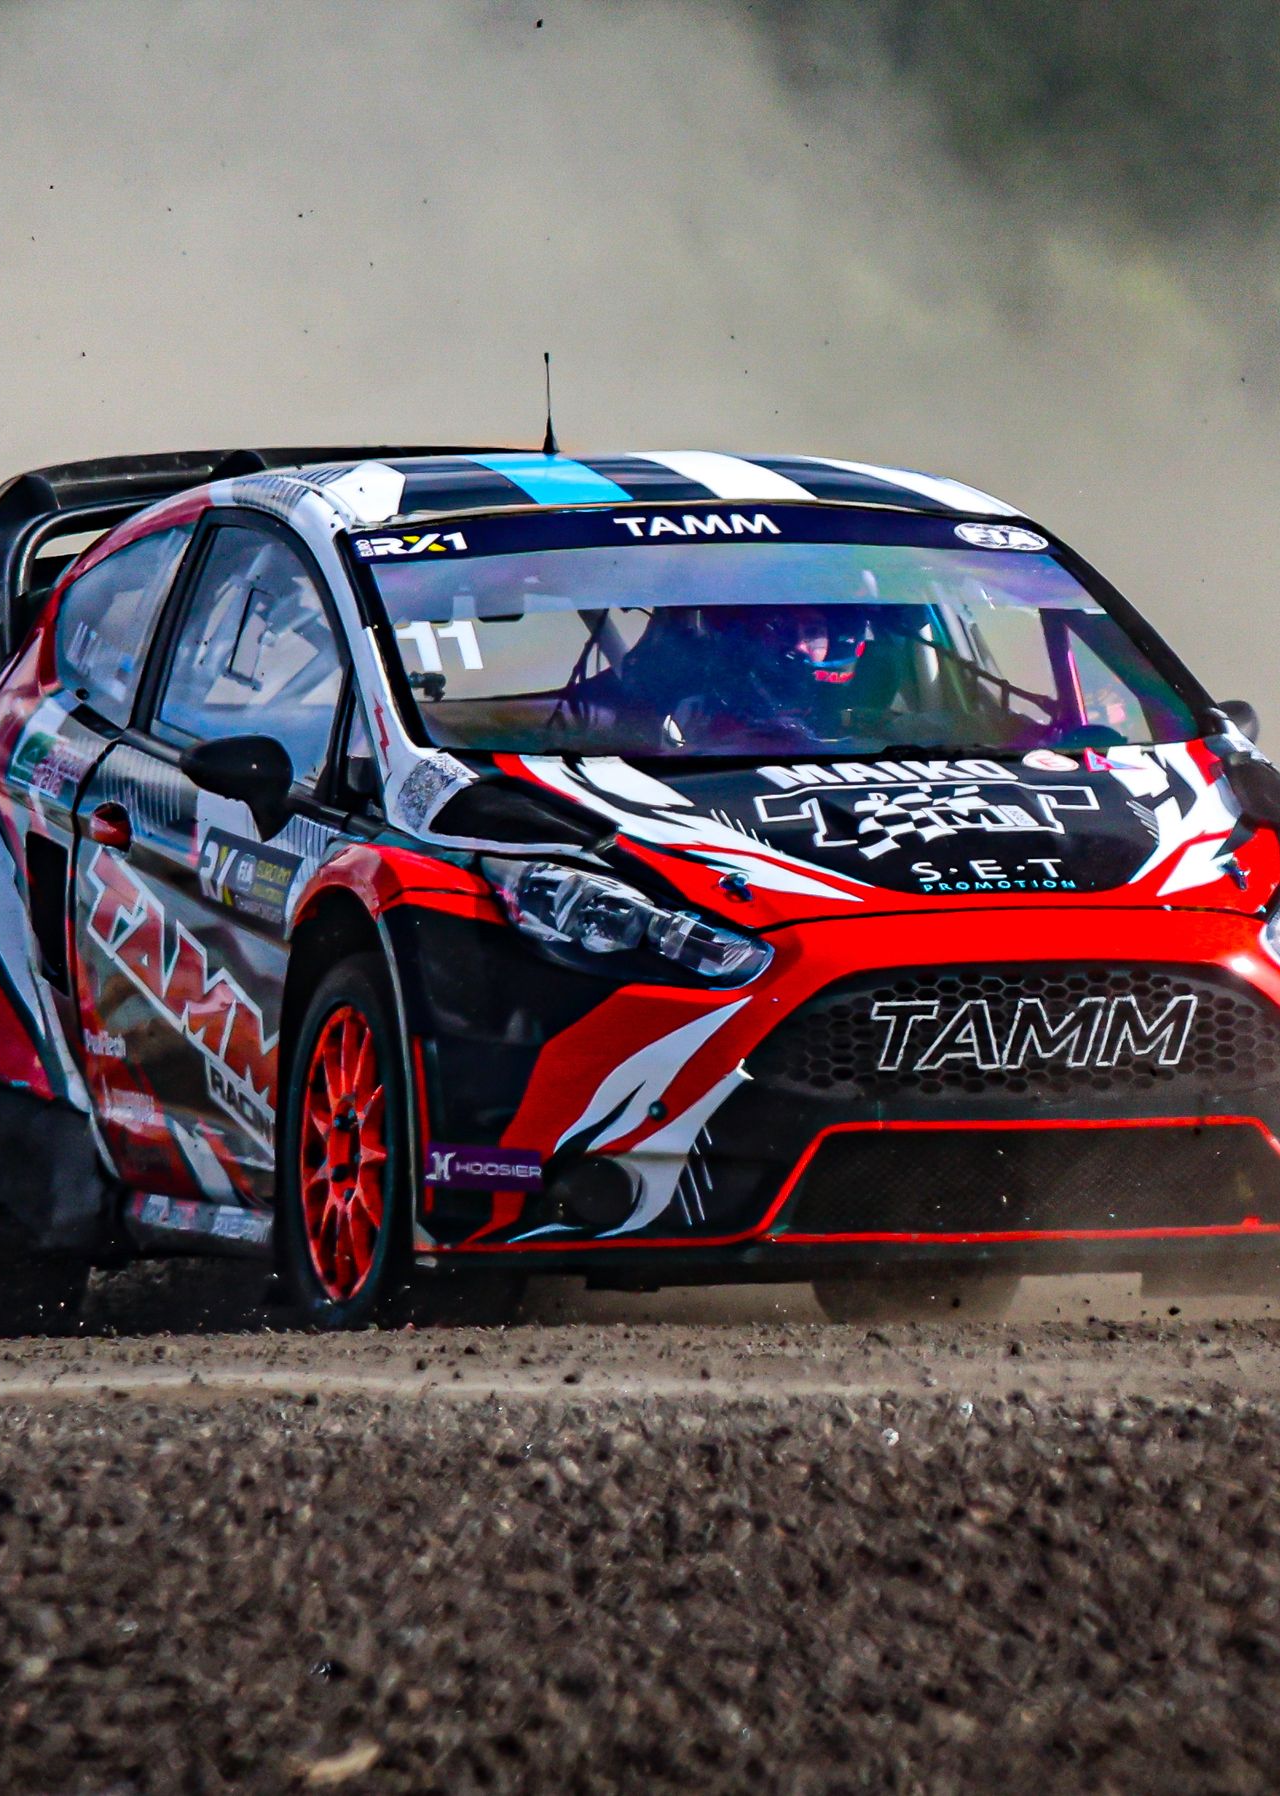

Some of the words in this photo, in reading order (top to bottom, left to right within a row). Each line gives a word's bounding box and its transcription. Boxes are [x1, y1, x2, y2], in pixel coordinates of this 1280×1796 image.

[613, 514, 782, 537] TAMM
[370, 532, 468, 555] RX1
[395, 620, 484, 671] 11
[756, 759, 1019, 789] MAIKO
[923, 880, 1077, 893] PROMOTION
[871, 994, 1198, 1071] TAMM
[455, 1160, 543, 1179] HOOSIER
